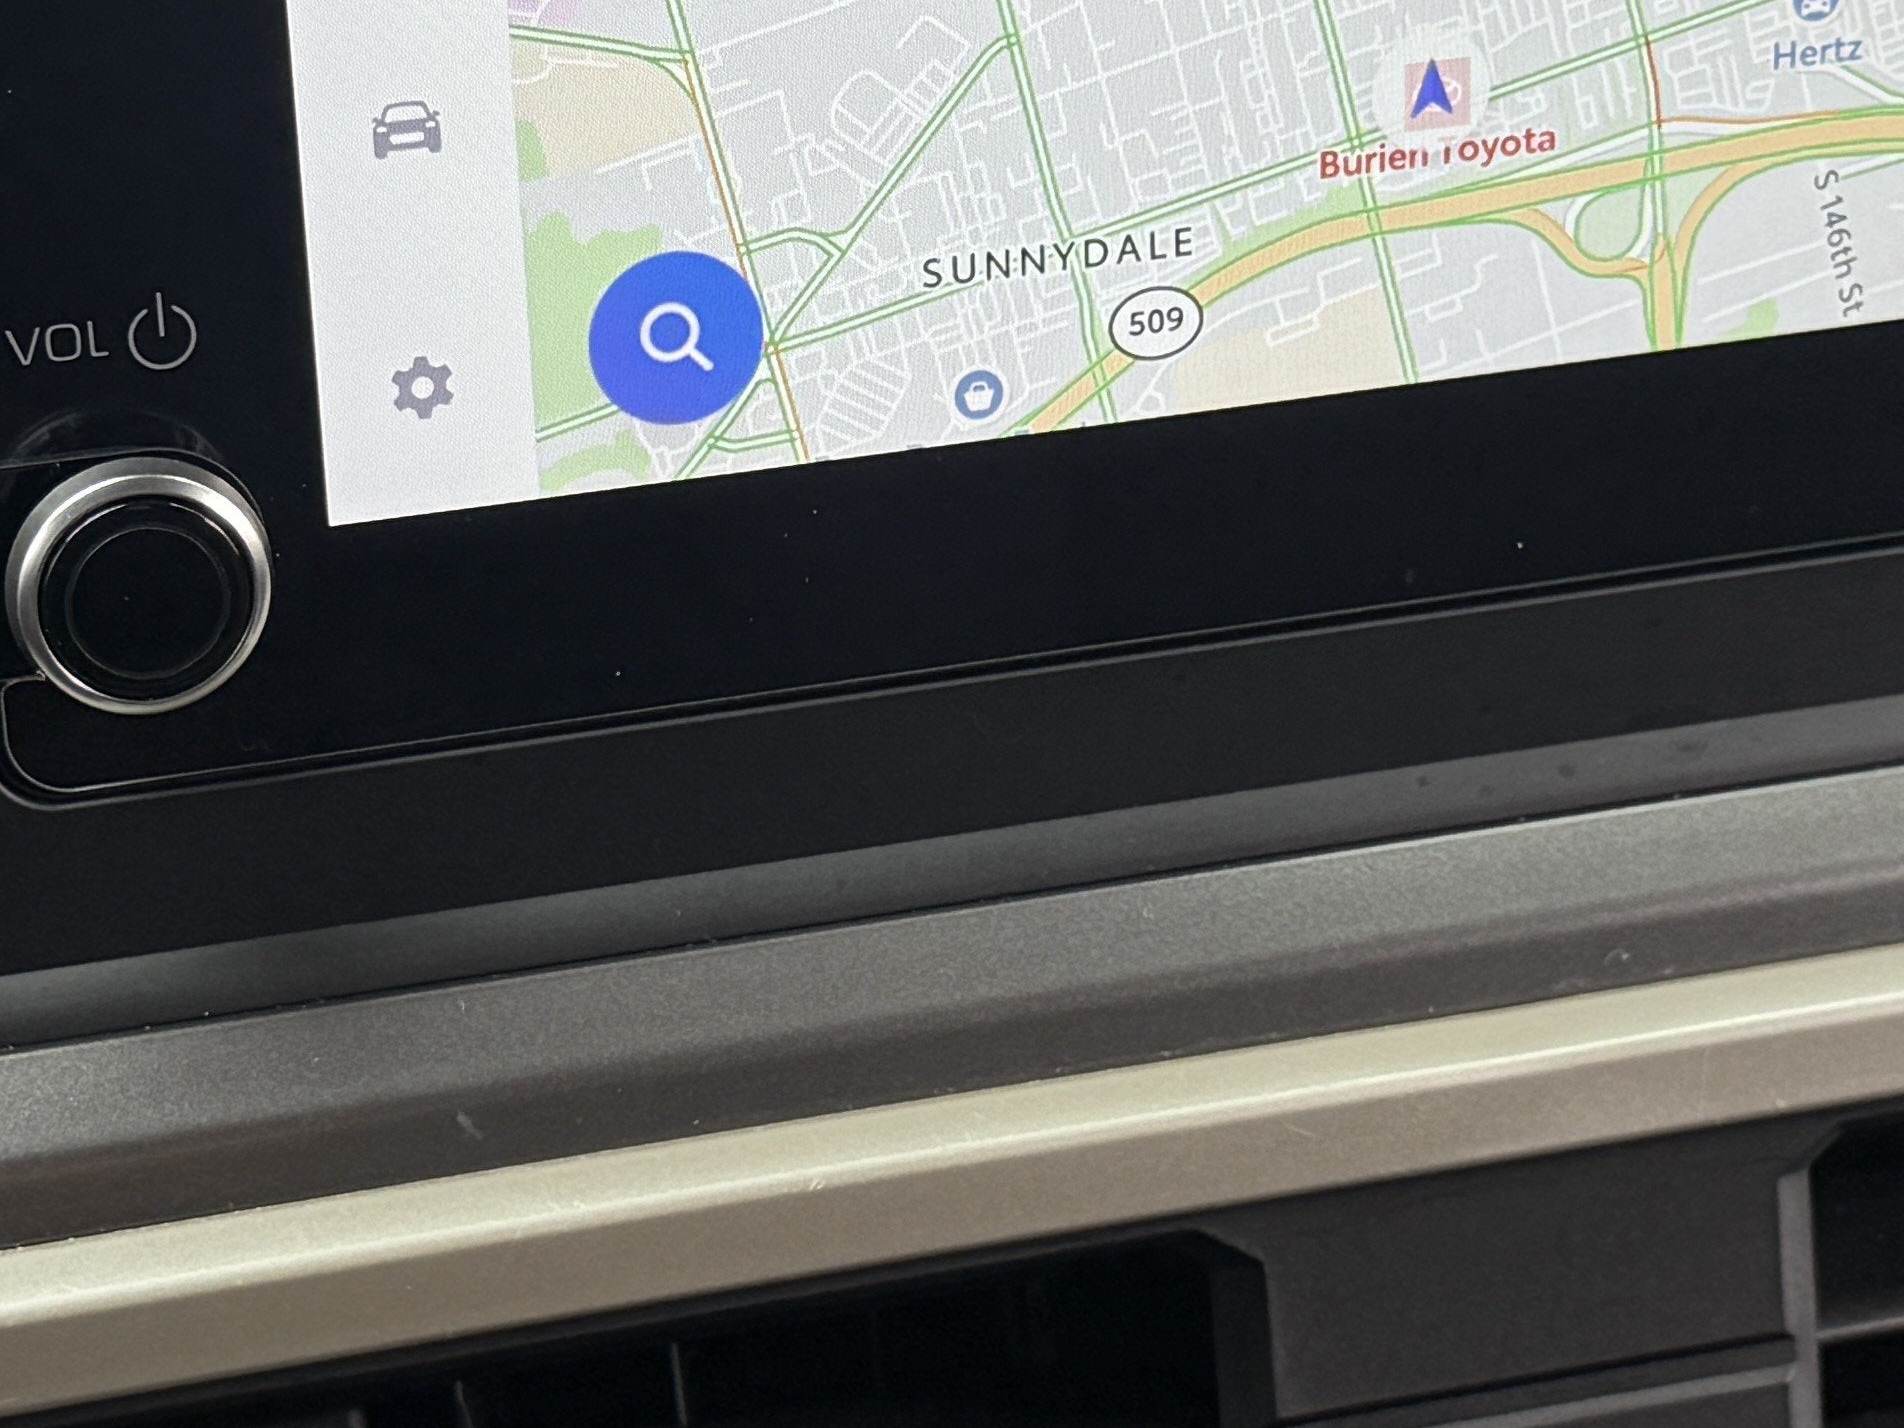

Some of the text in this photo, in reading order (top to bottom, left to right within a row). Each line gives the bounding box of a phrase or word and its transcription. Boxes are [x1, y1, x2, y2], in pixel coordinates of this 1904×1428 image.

[1772, 37, 1864, 71] Hertz
[1319, 142, 1429, 180] Burien
[922, 226, 1193, 289] SUNNYDALE
[1814, 169, 1864, 318] S 146th St
[1128, 306, 1184, 337] 509
[5, 320, 110, 367] VOL
